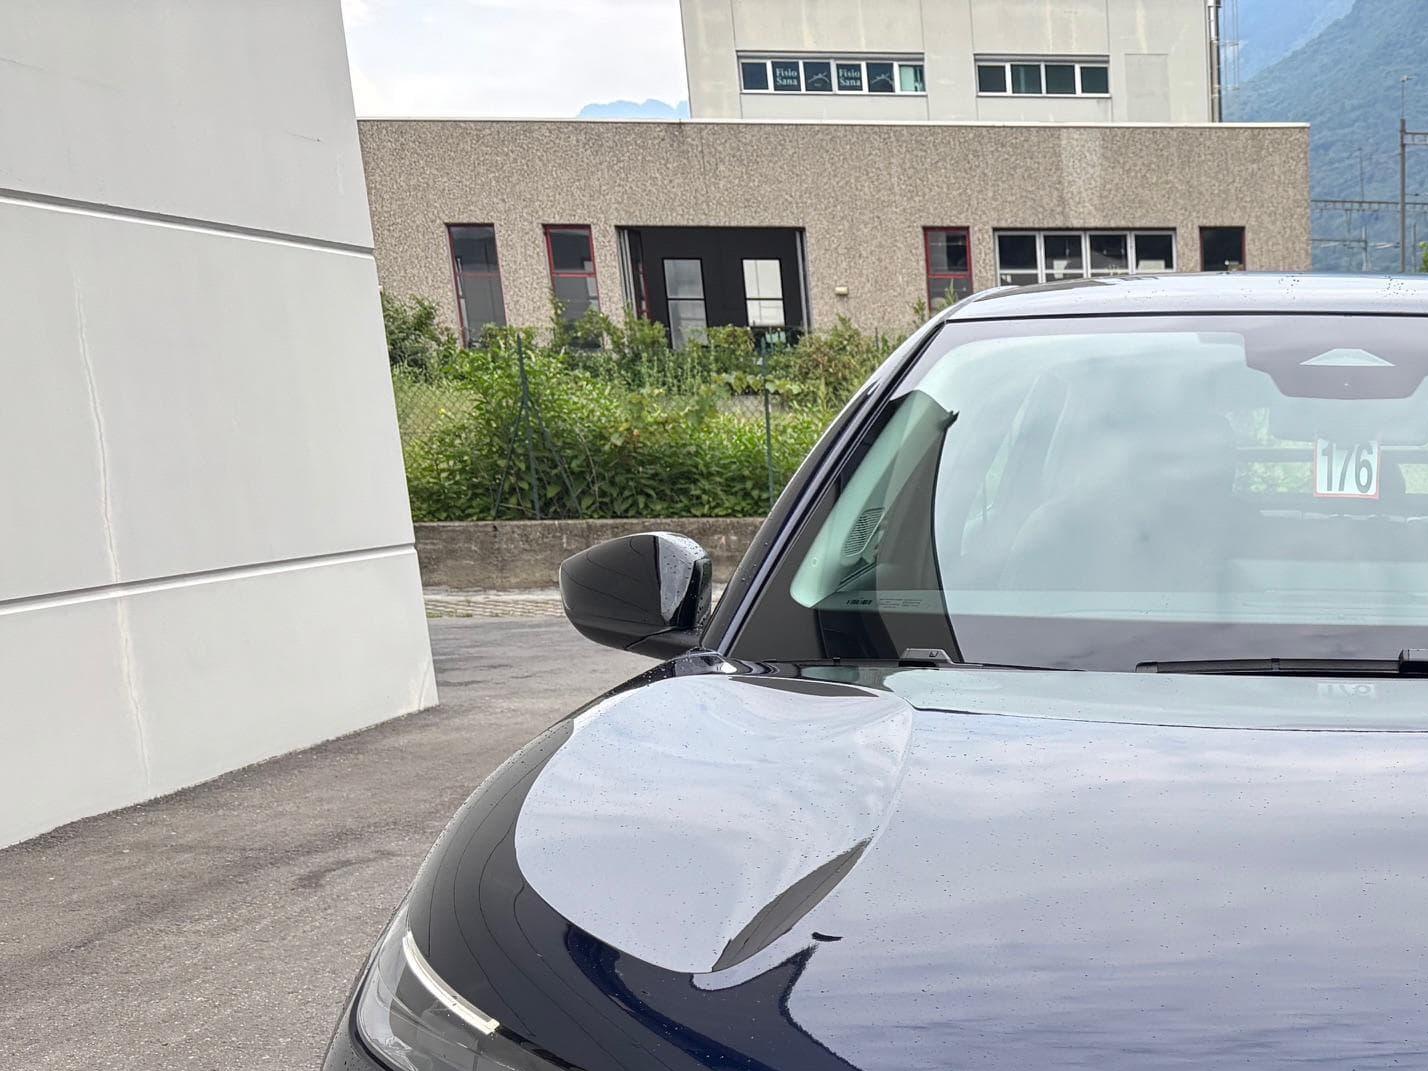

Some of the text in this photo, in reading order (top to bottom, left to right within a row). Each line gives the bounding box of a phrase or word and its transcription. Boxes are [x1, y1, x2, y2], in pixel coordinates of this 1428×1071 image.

[775, 67, 798, 77] Fisio
[838, 68, 861, 78] Fisio
[775, 77, 798, 86] Sana
[839, 77, 862, 87] Sana
[1320, 441, 1373, 494] 176
